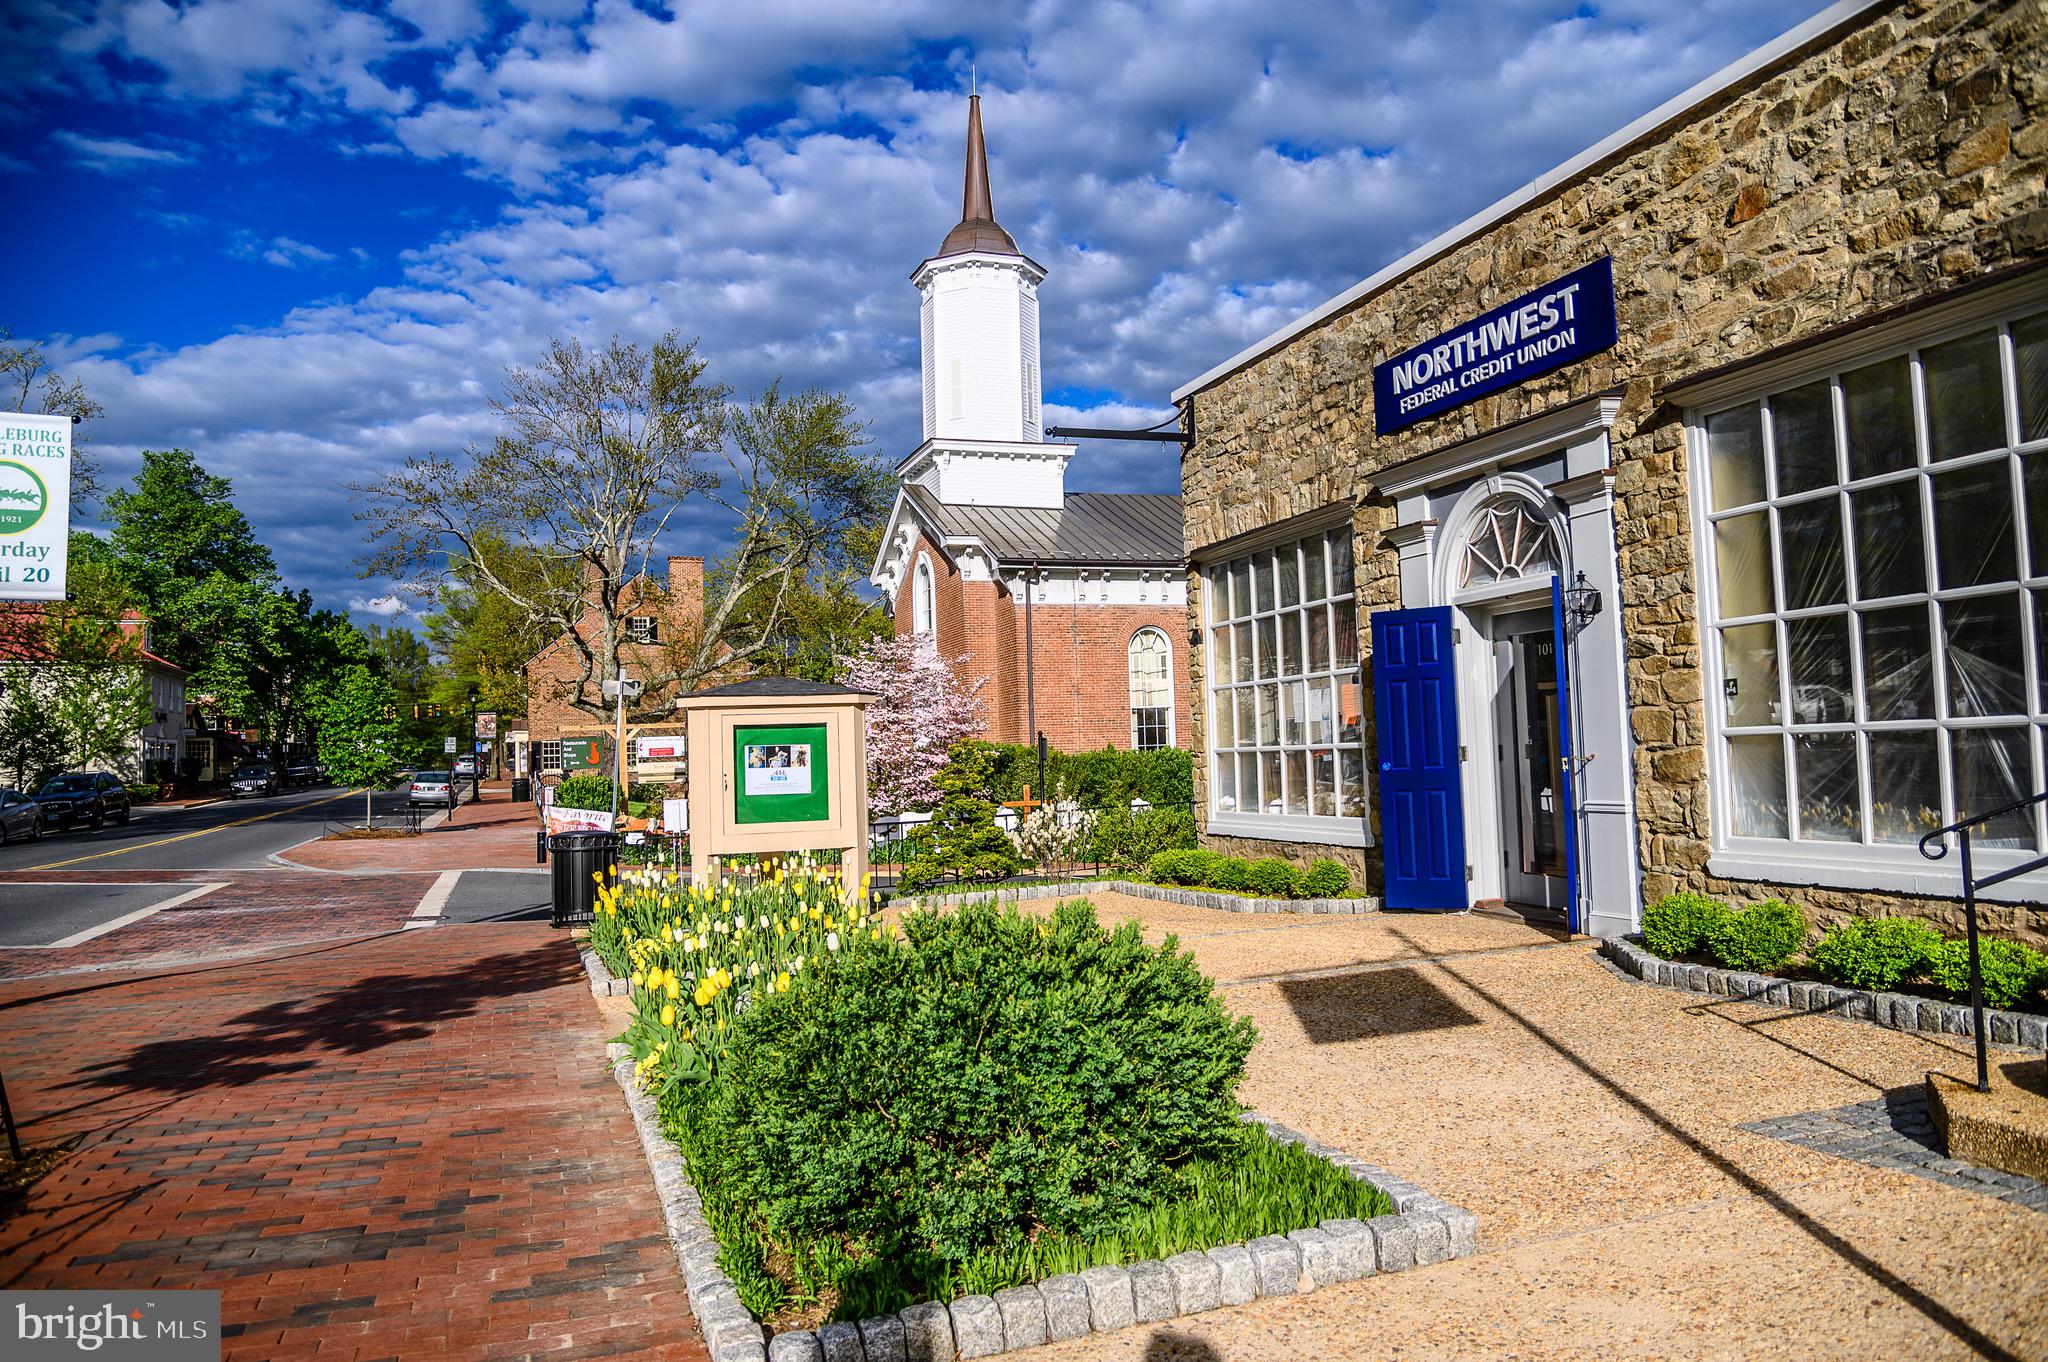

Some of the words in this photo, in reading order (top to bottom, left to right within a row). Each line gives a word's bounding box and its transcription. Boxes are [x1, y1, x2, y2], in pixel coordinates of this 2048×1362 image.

[1392, 283, 1579, 395] NORTHWEST
[1400, 378, 1458, 414] FEDERAL
[1460, 352, 1514, 388] CREDIT
[1517, 328, 1576, 365] UNION
[0, 428, 62, 443] EBURG
[12, 443, 65, 459] RACES
[1, 515, 22, 523] 1921
[23, 567, 50, 583] 20
[1537, 643, 1553, 656] 101
